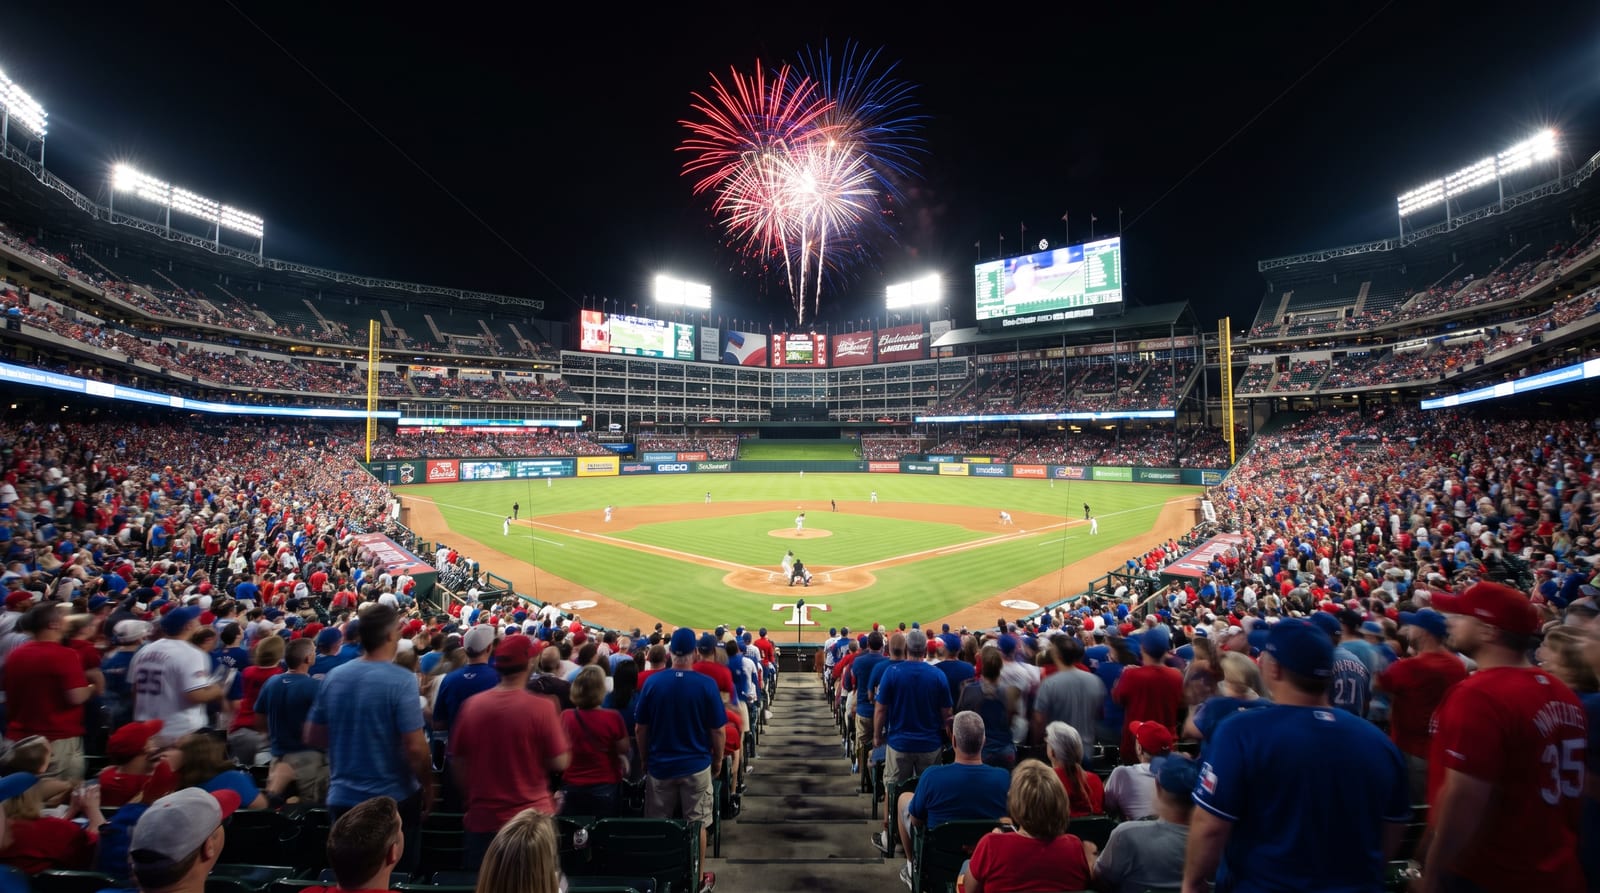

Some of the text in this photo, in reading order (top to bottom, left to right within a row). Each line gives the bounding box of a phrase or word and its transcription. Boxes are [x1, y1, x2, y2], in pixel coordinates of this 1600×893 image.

[657, 463, 688, 471] GEICO
[136, 668, 162, 695] 25
[1334, 678, 1356, 704] 27
[1542, 738, 1585, 805] 35
